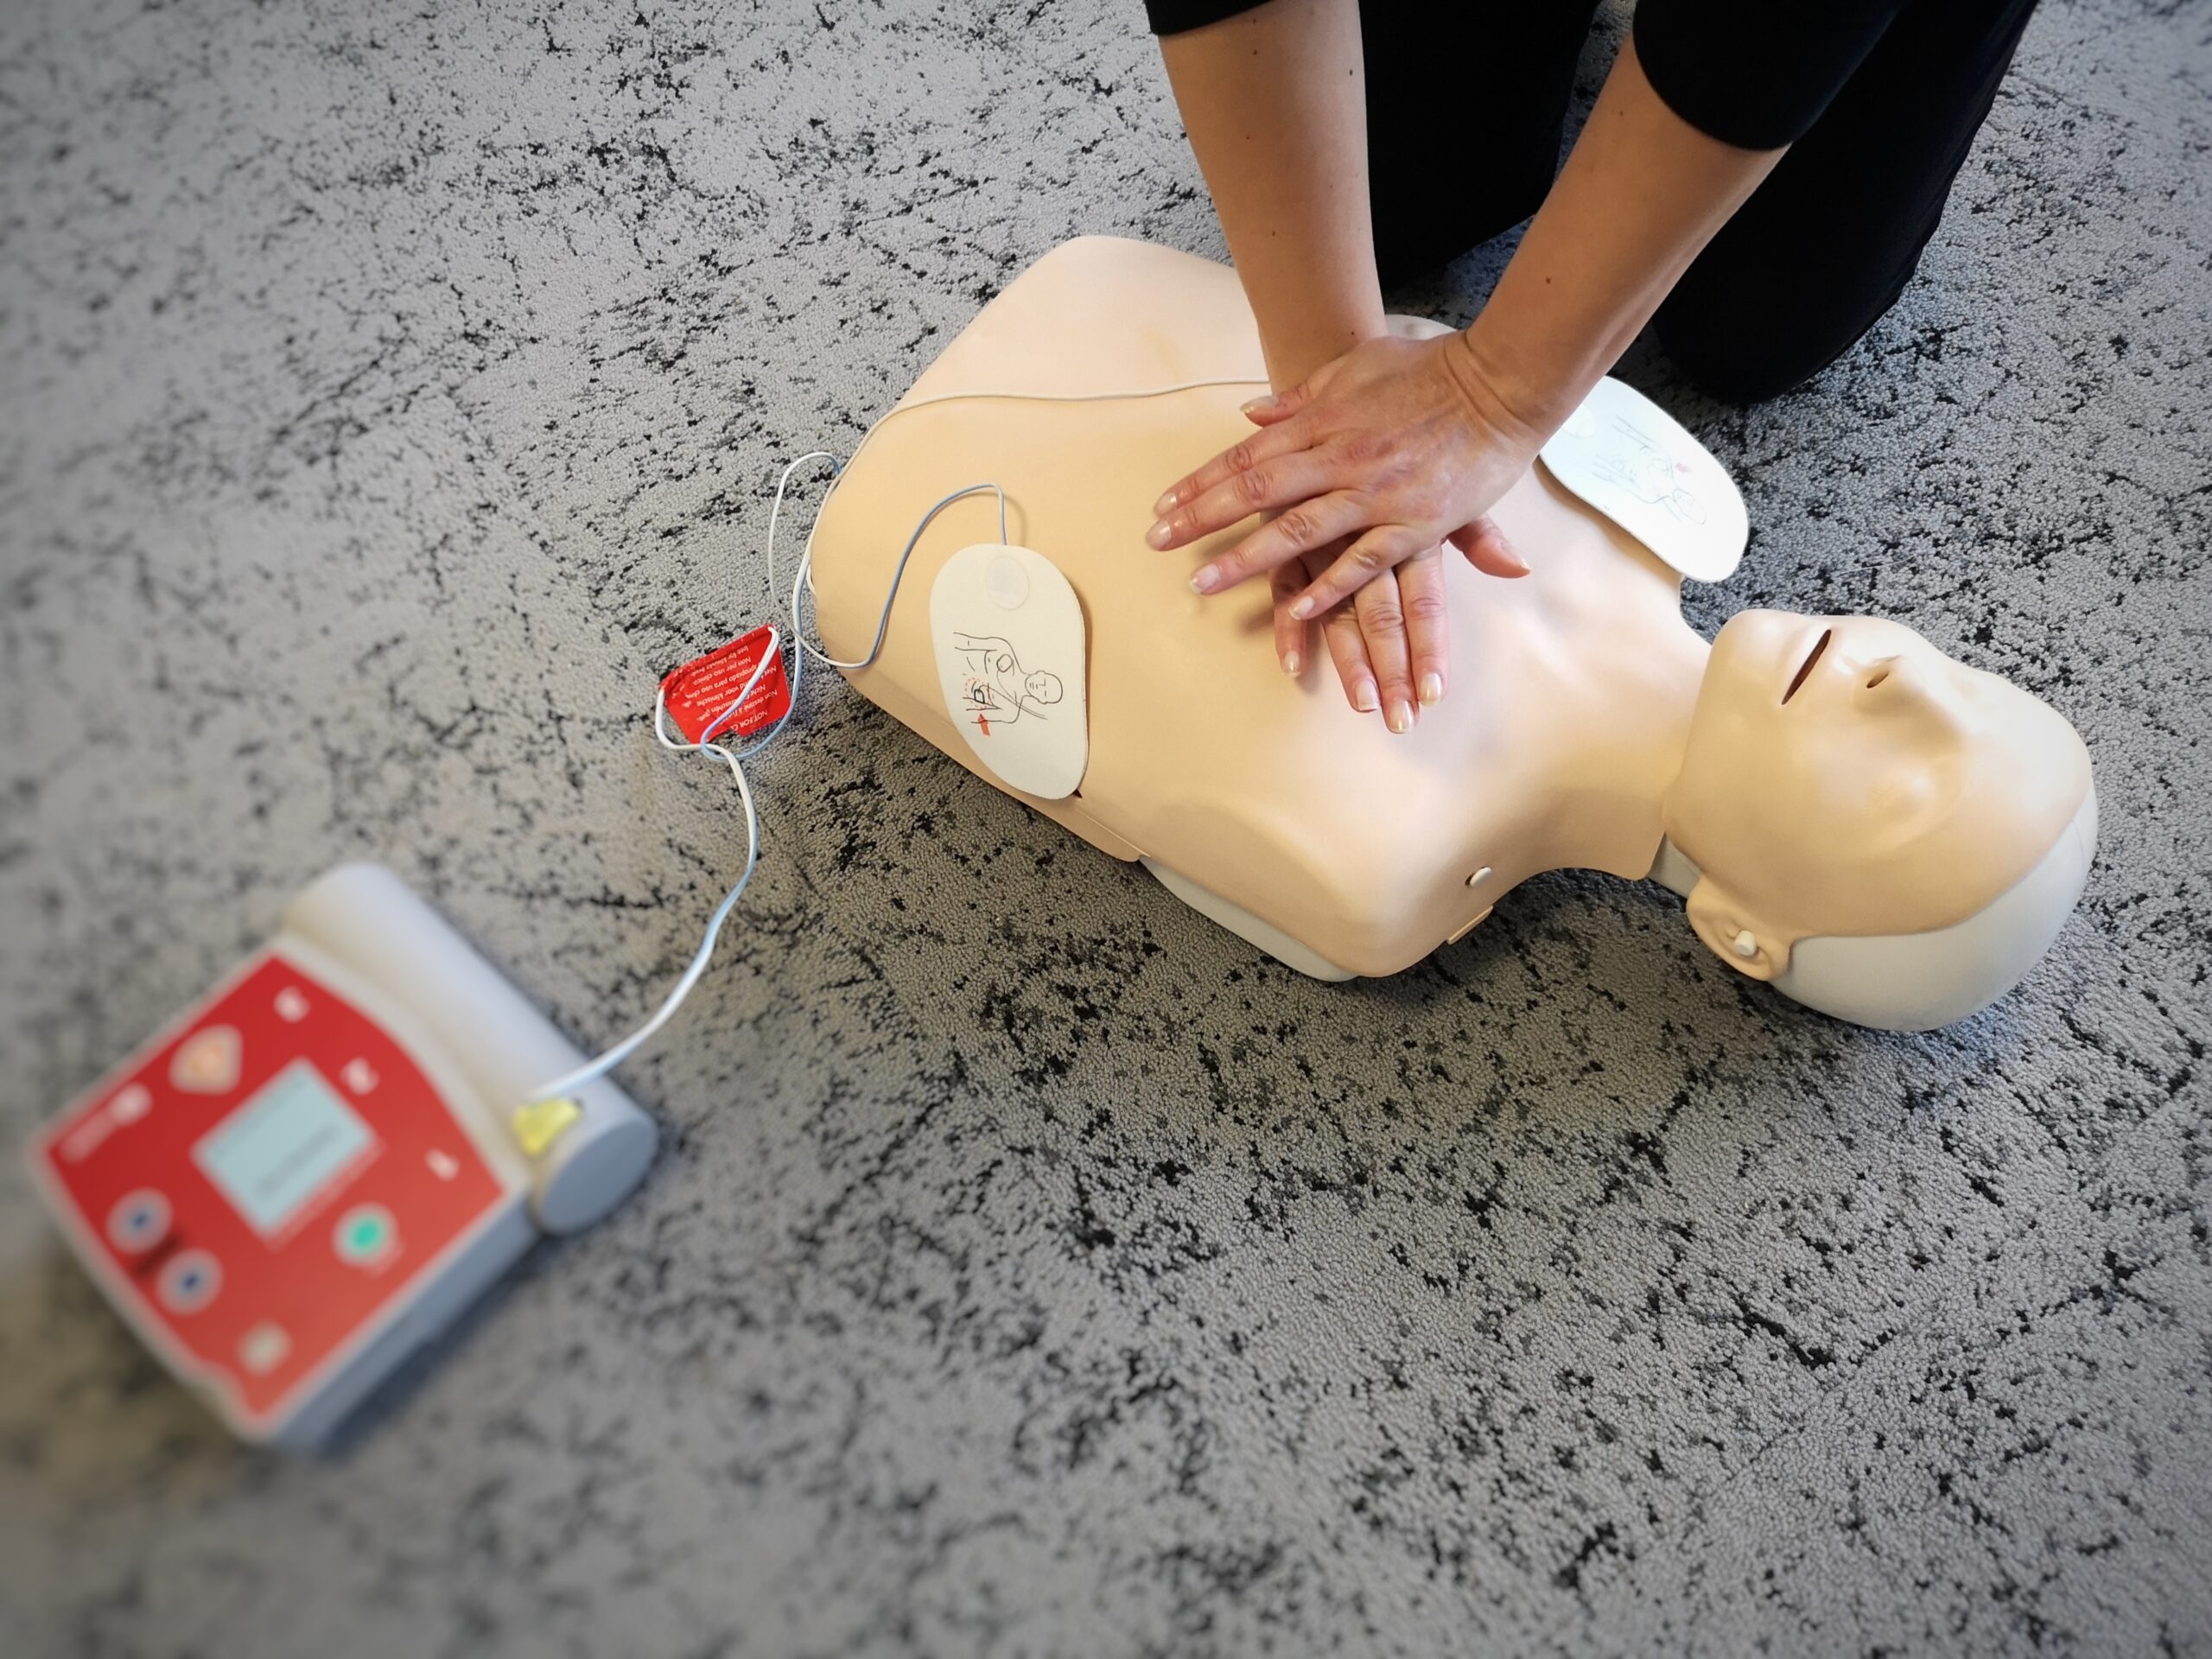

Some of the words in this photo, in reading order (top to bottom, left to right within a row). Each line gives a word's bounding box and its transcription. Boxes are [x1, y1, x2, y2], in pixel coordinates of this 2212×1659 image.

[738, 655, 752, 666] Non
[726, 662, 737, 671] per
[713, 668, 725, 677] uso
[714, 677, 728, 689] para
[724, 686, 739, 696] voor
[765, 689, 778, 700] Non
[696, 693, 724, 706] klinische
[753, 709, 768, 721] NOT
[740, 717, 753, 728] FOR
